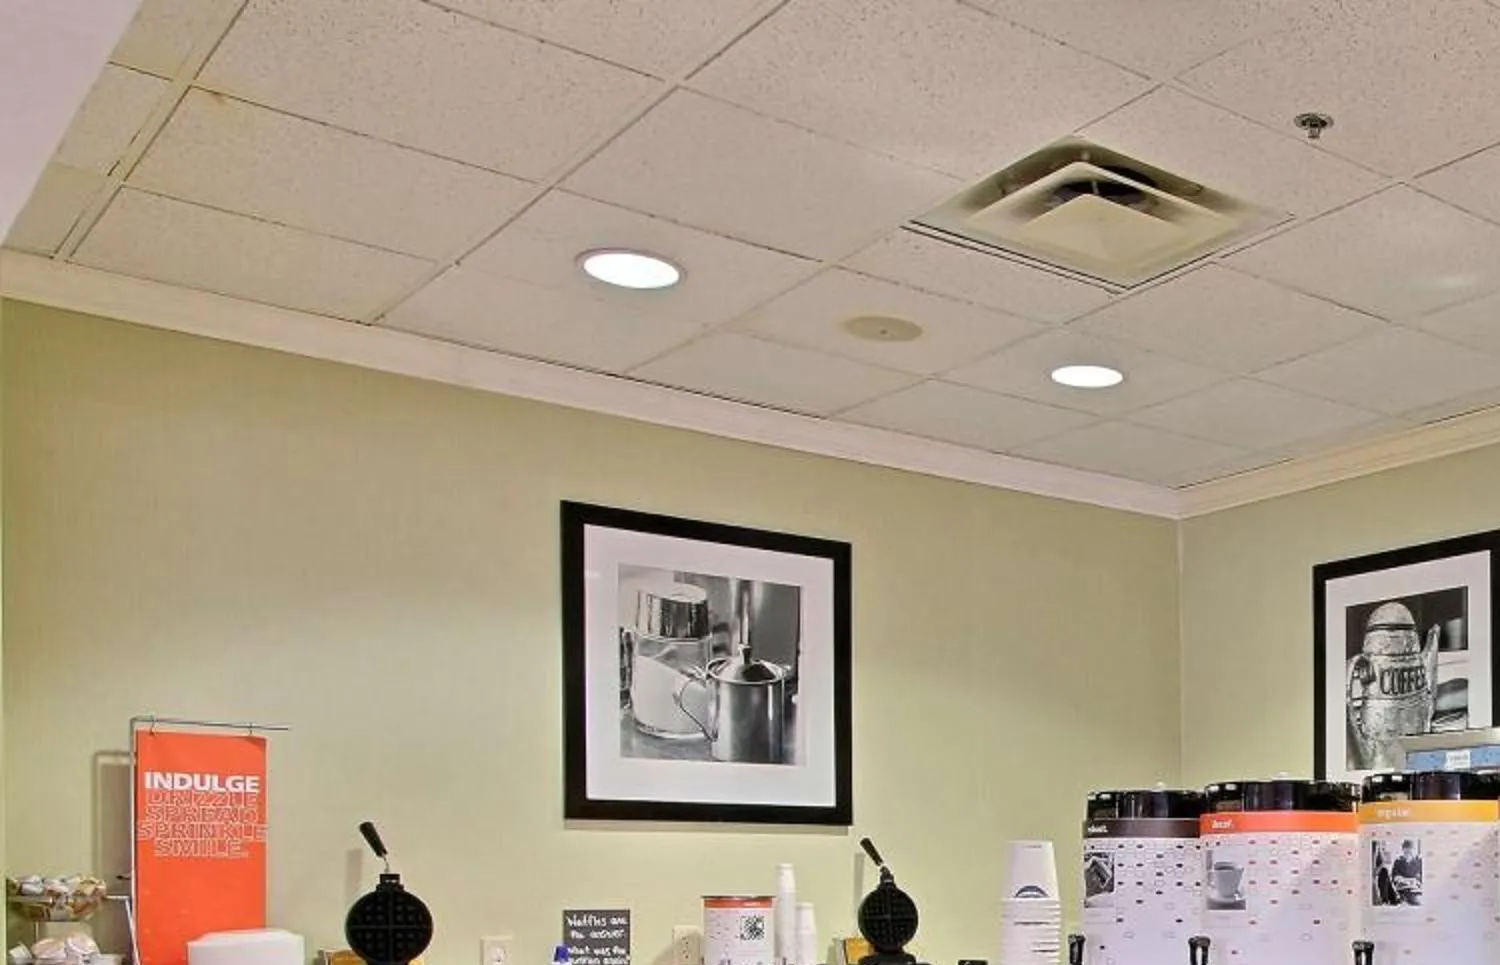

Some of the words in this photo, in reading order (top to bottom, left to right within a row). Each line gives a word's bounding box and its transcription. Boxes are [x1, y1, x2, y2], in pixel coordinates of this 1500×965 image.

[144, 771, 260, 793] INDULGE
[145, 805, 258, 824] SPREAD
[137, 821, 268, 842] SPRINKLE
